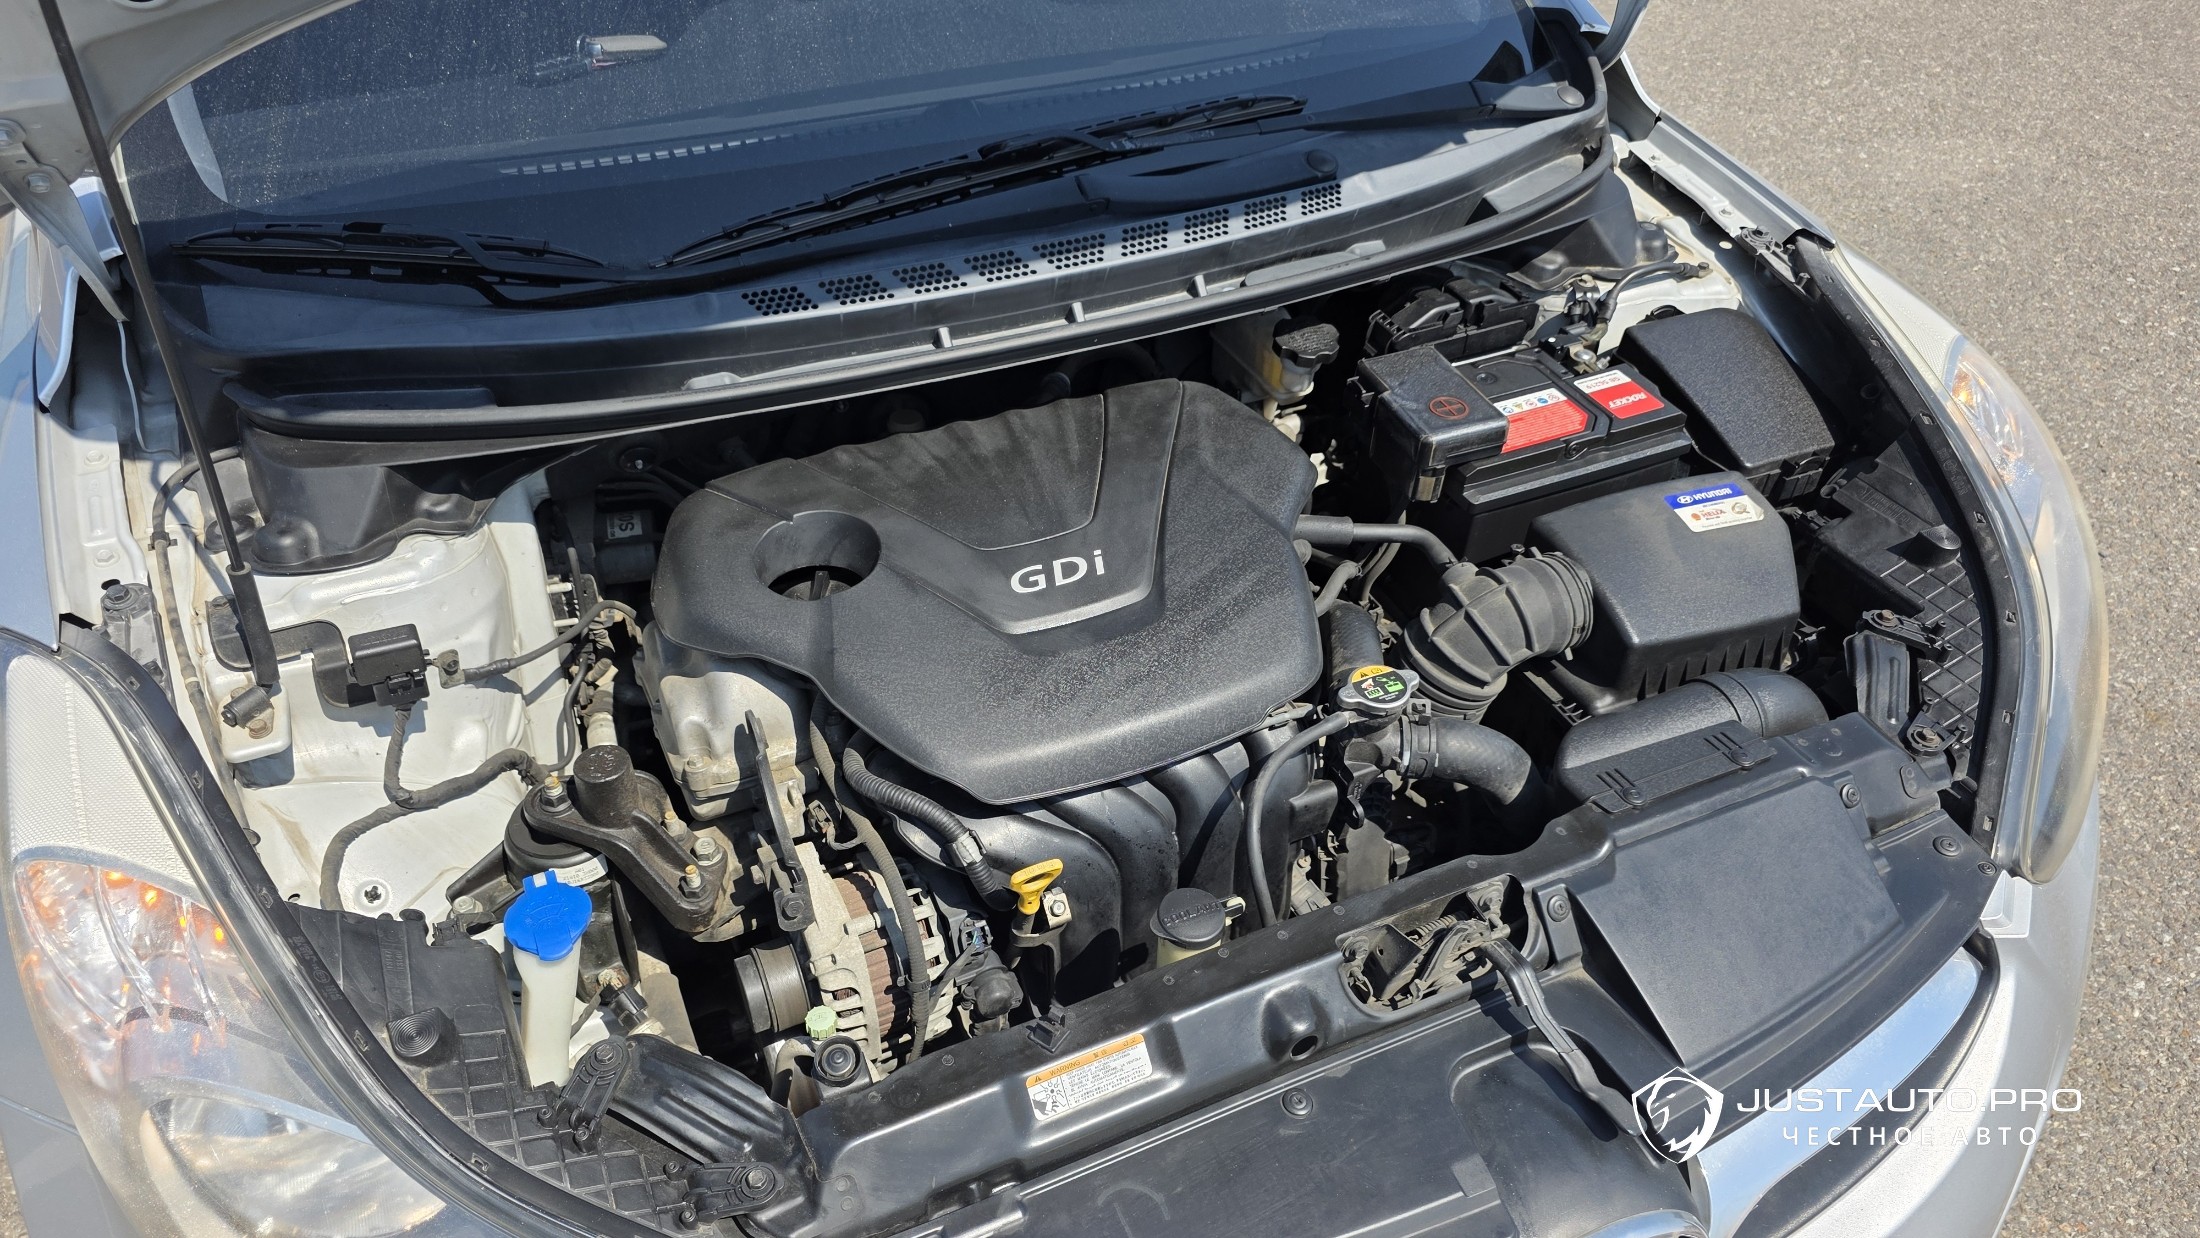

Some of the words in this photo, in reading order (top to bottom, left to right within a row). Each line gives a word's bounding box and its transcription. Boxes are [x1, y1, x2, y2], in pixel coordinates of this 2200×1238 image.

[1608, 391, 1648, 408] ROCKET
[1693, 487, 1733, 501] HYUNDAI
[1010, 549, 1105, 594] GDi
[1161, 901, 1221, 926] COOLANT
[1049, 1060, 1081, 1077] WARNING
